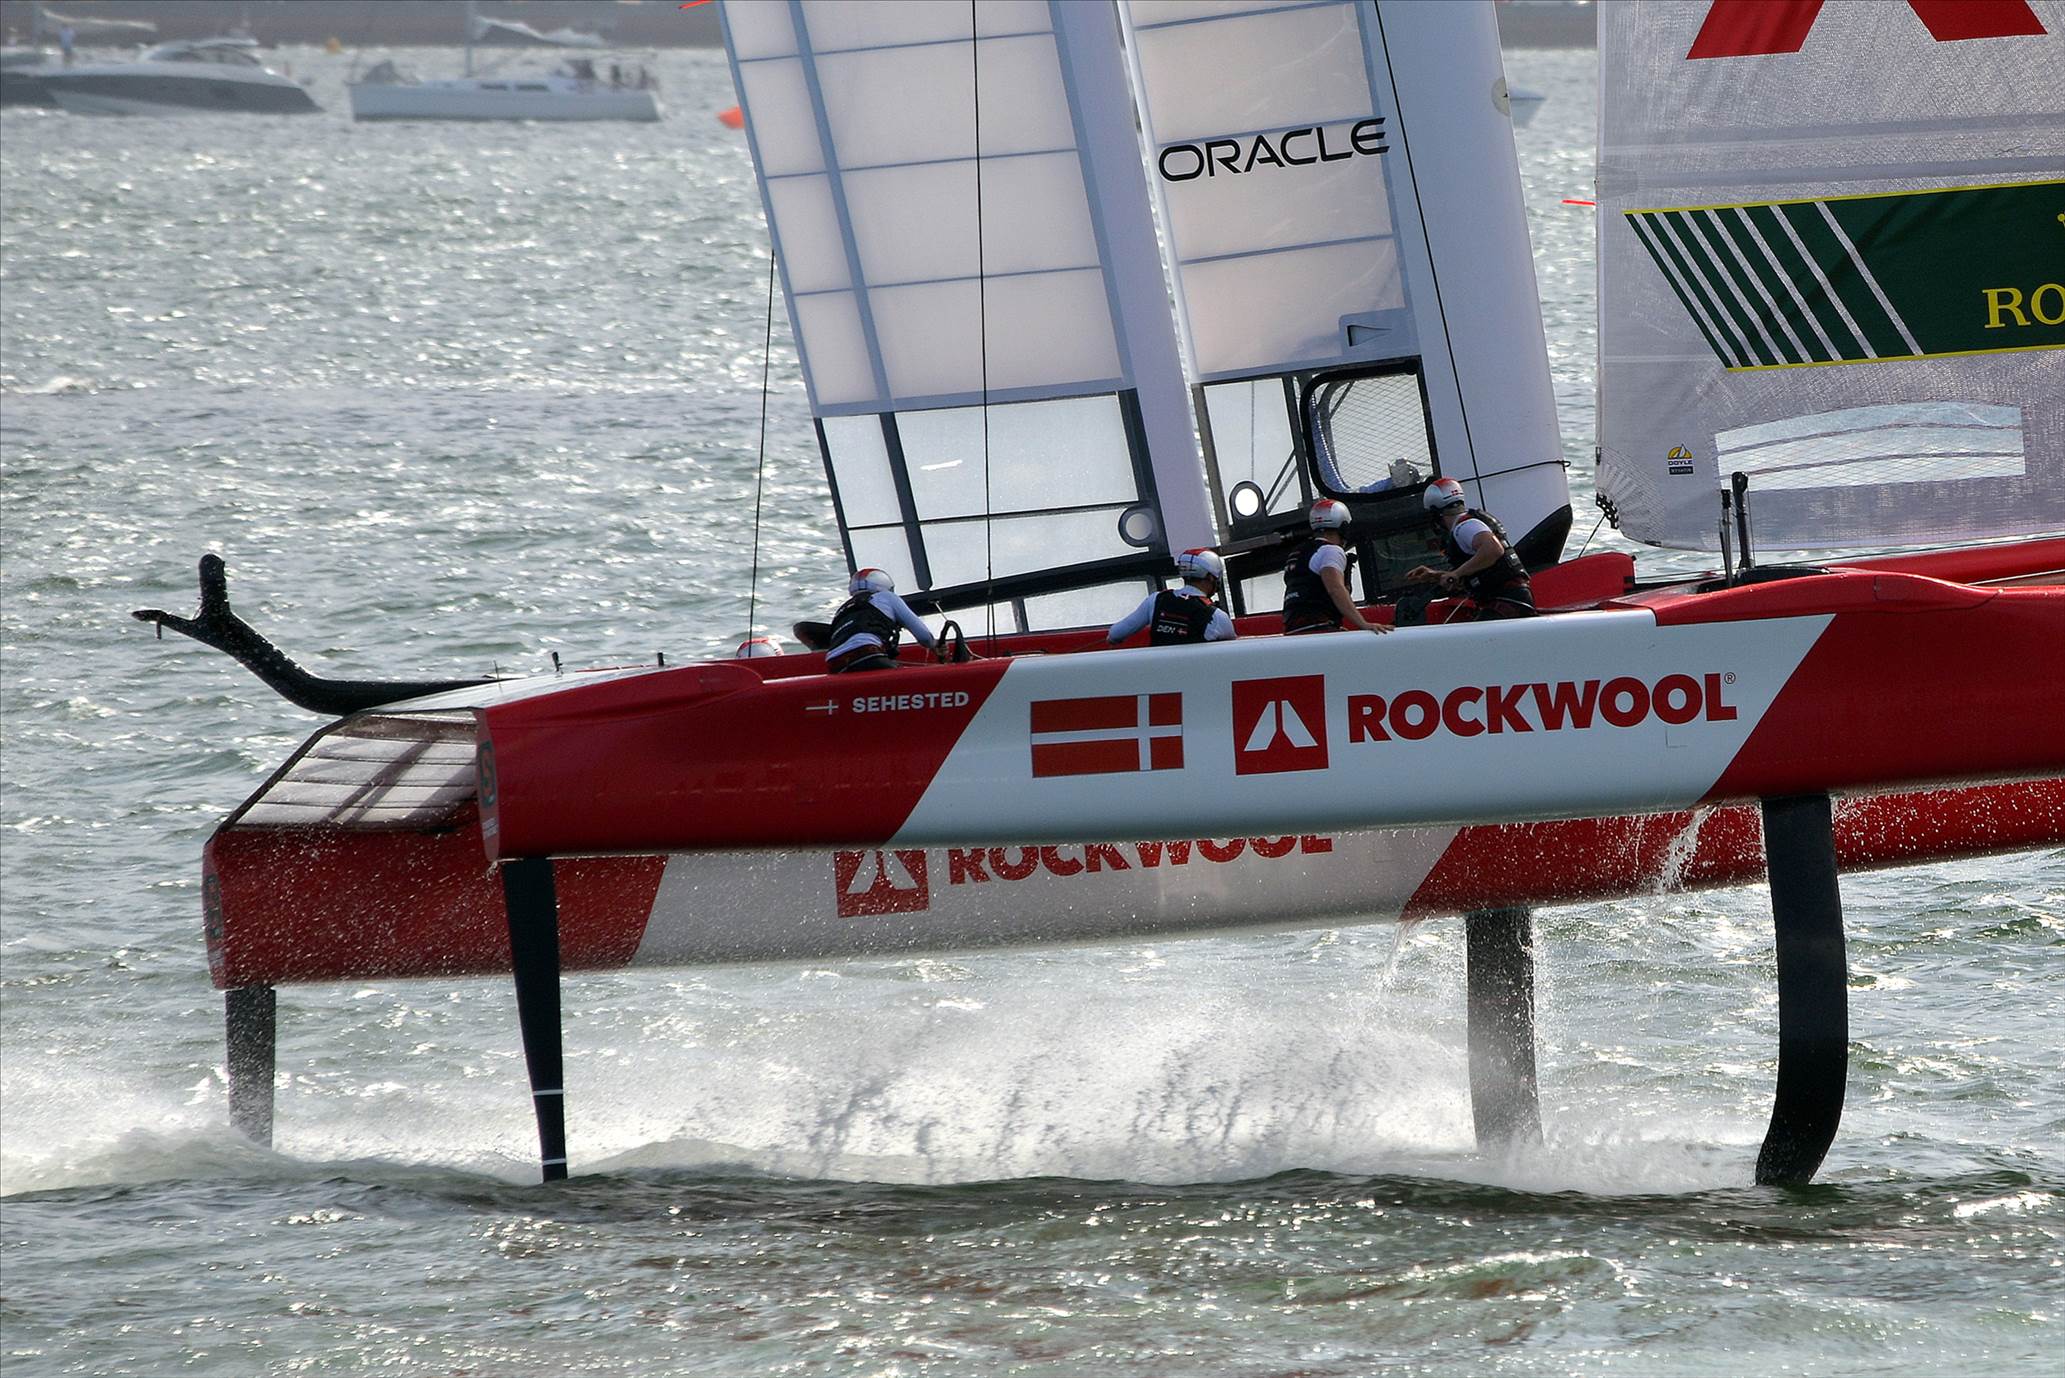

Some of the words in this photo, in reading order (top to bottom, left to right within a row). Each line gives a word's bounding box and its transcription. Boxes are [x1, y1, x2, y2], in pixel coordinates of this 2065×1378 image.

[1158, 117, 1390, 182] ORACLE
[1982, 283, 2065, 328] RO
[852, 691, 969, 713] SEHESTED
